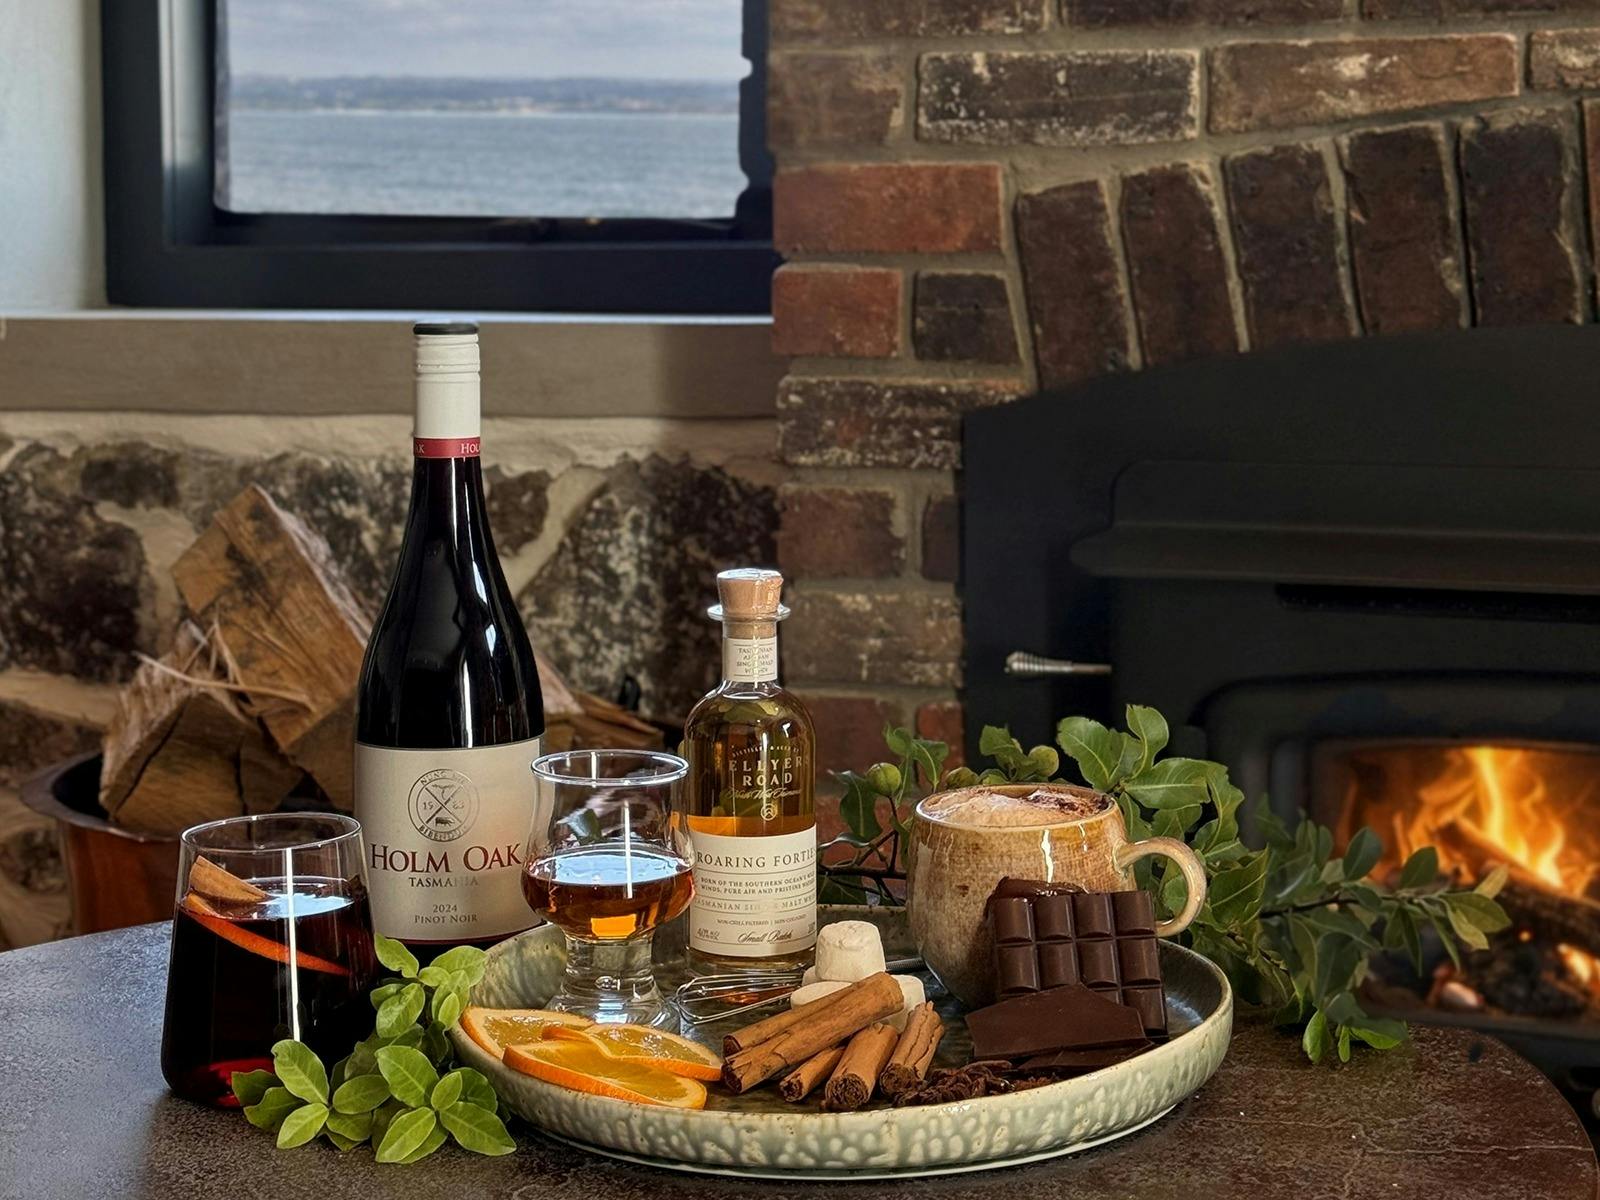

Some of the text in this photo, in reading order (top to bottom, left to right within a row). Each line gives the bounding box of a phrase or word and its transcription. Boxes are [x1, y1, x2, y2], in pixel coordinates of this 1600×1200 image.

[742, 772, 793, 786] ROAD
[370, 843, 522, 873] HOLM OAK
[697, 848, 816, 868] ROARING FORTIE
[701, 877, 719, 885] BORN
[745, 880, 783, 888] SOUTHERN
[774, 883, 801, 893] PRISTINE
[432, 904, 458, 913] 2024
[782, 898, 802, 908] MALT
[414, 914, 478, 924] PINOT NOIR
[737, 930, 768, 943] Small
